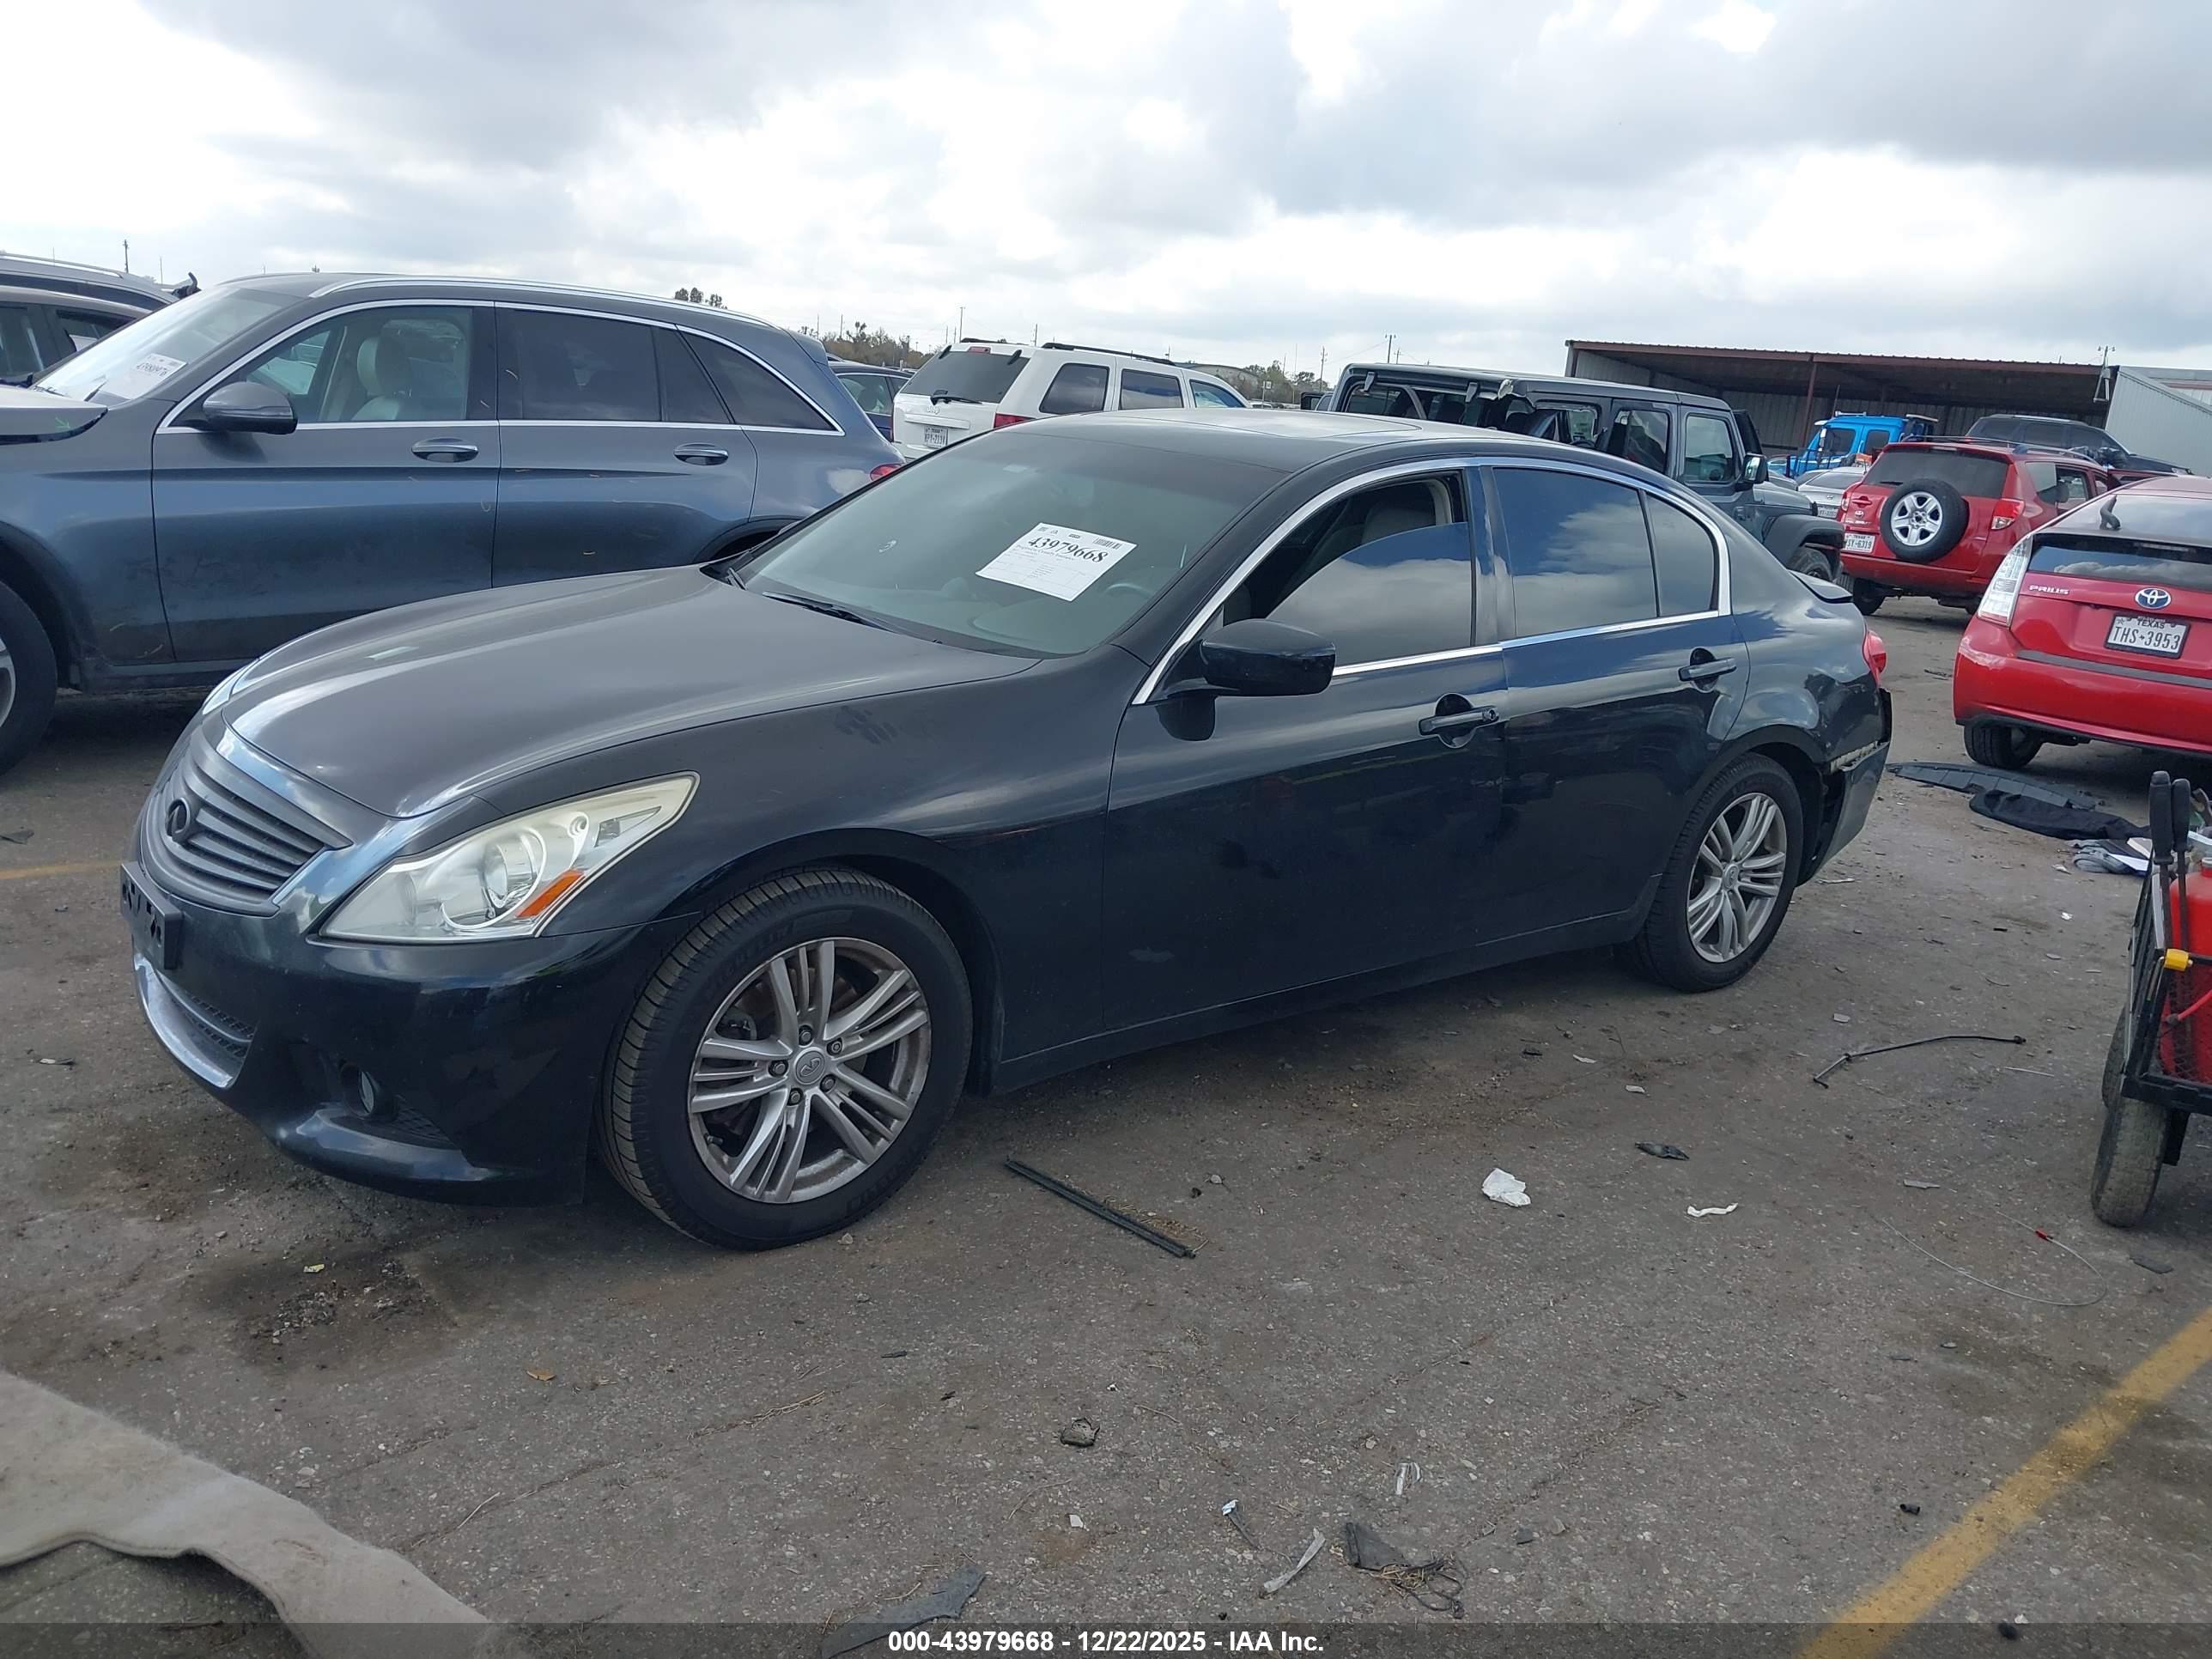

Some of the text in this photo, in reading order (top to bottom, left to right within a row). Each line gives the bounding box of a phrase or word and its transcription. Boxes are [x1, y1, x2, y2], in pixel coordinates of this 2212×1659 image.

[1028, 536, 1109, 563] 43979668
[2029, 585, 2070, 595] PRIUS
[2136, 618, 2165, 629] TEXAS
